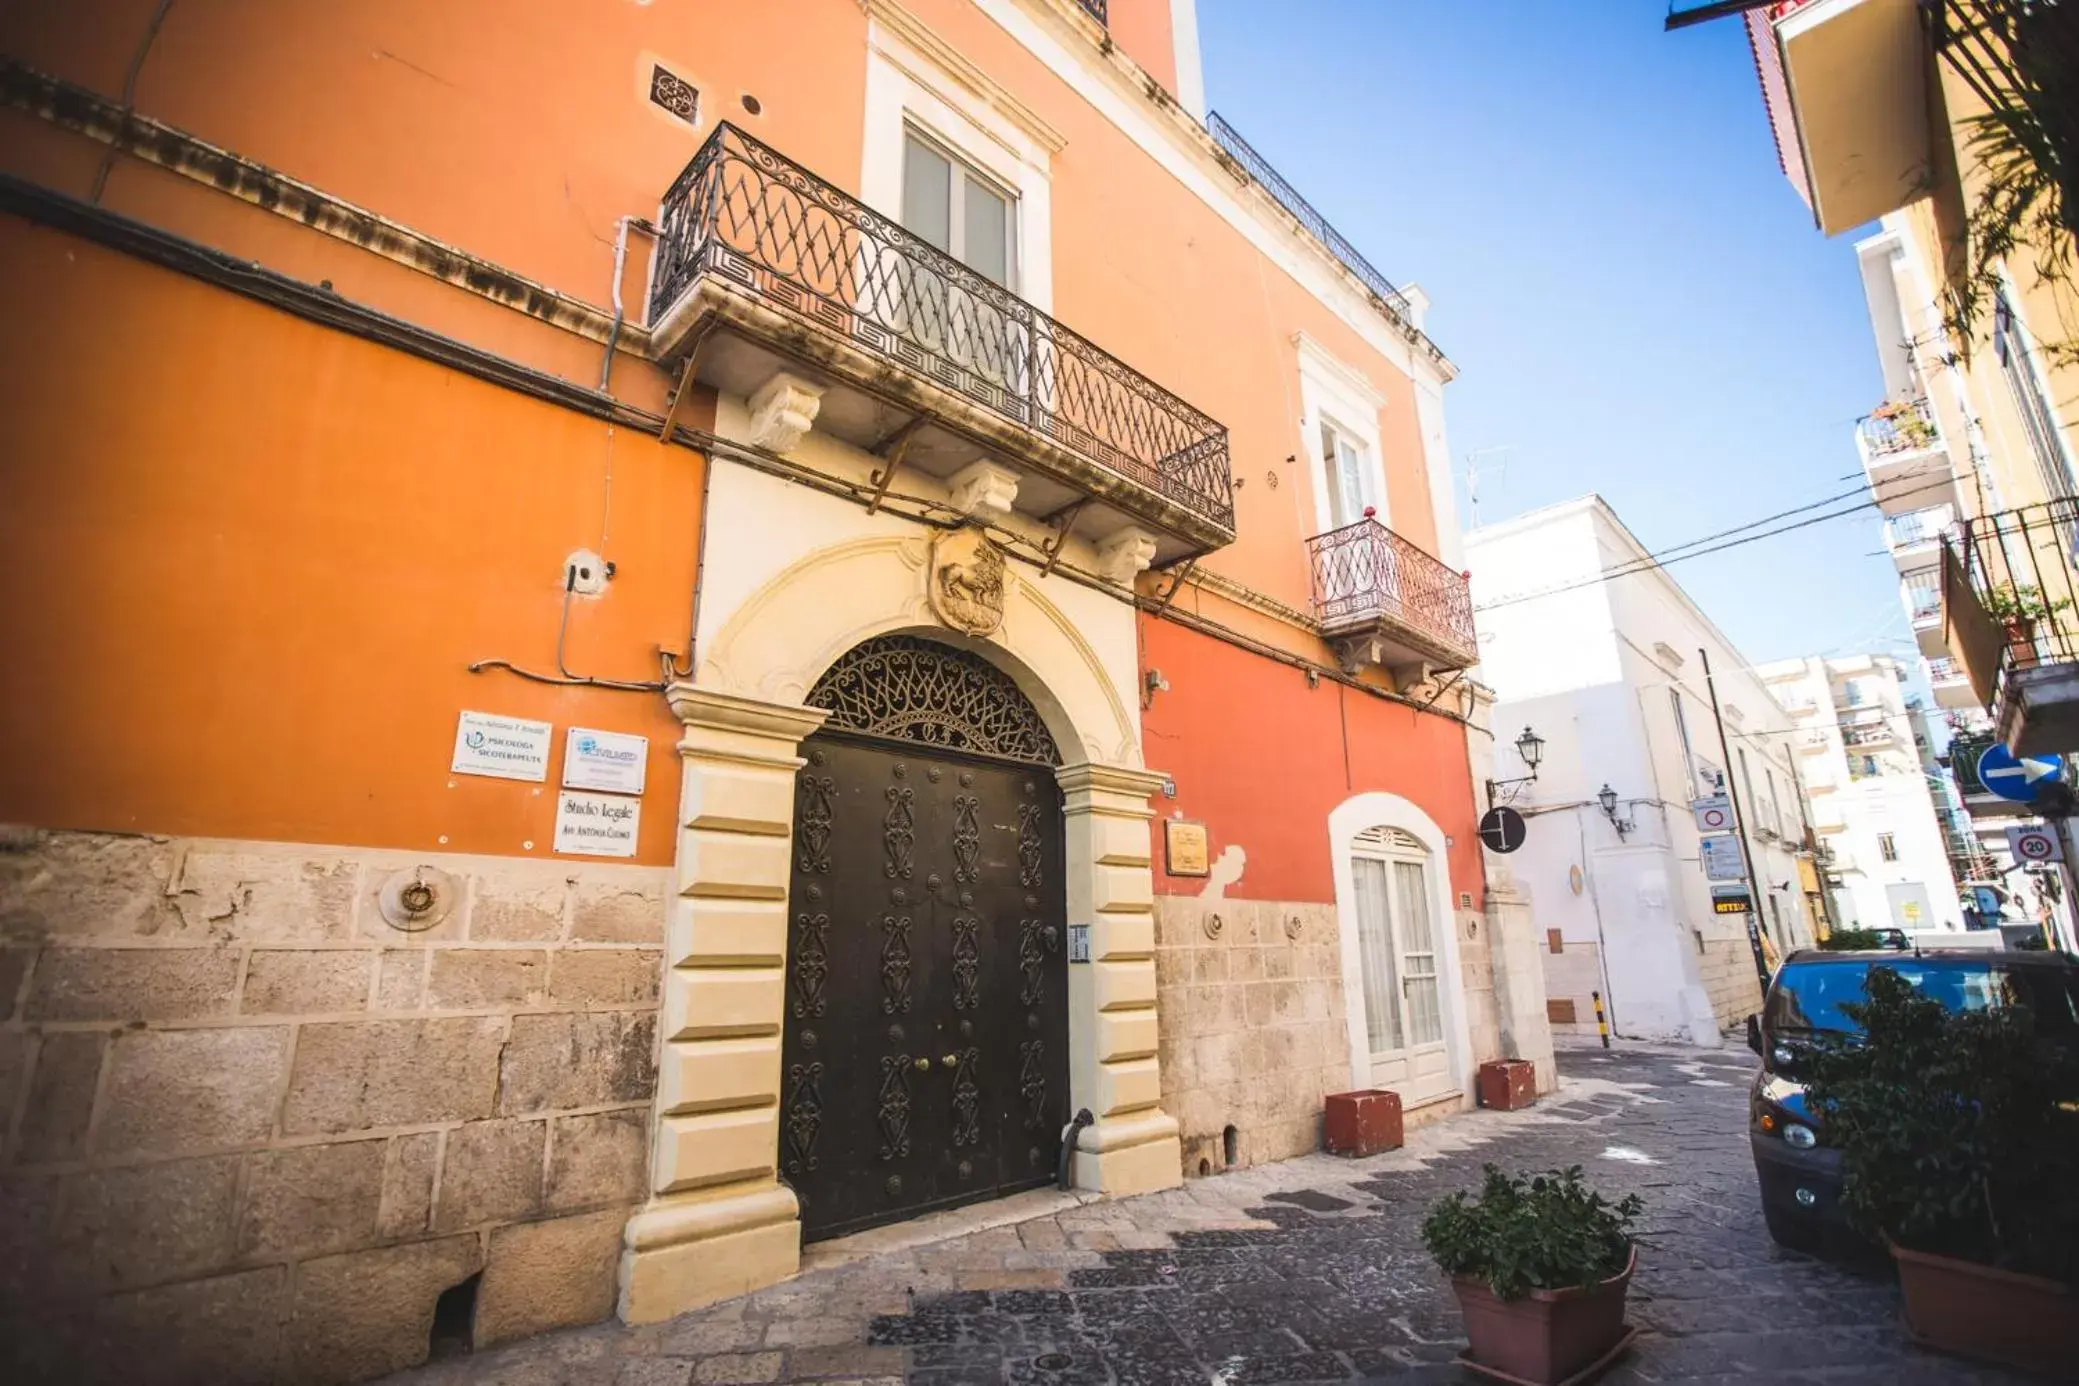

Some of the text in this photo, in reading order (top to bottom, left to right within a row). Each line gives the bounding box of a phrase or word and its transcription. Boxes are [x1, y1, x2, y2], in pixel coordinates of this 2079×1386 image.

[488, 737, 534, 749] PSICOLOGA
[564, 799, 633, 822] Studio Legale
[2026, 840, 2045, 853] 20
